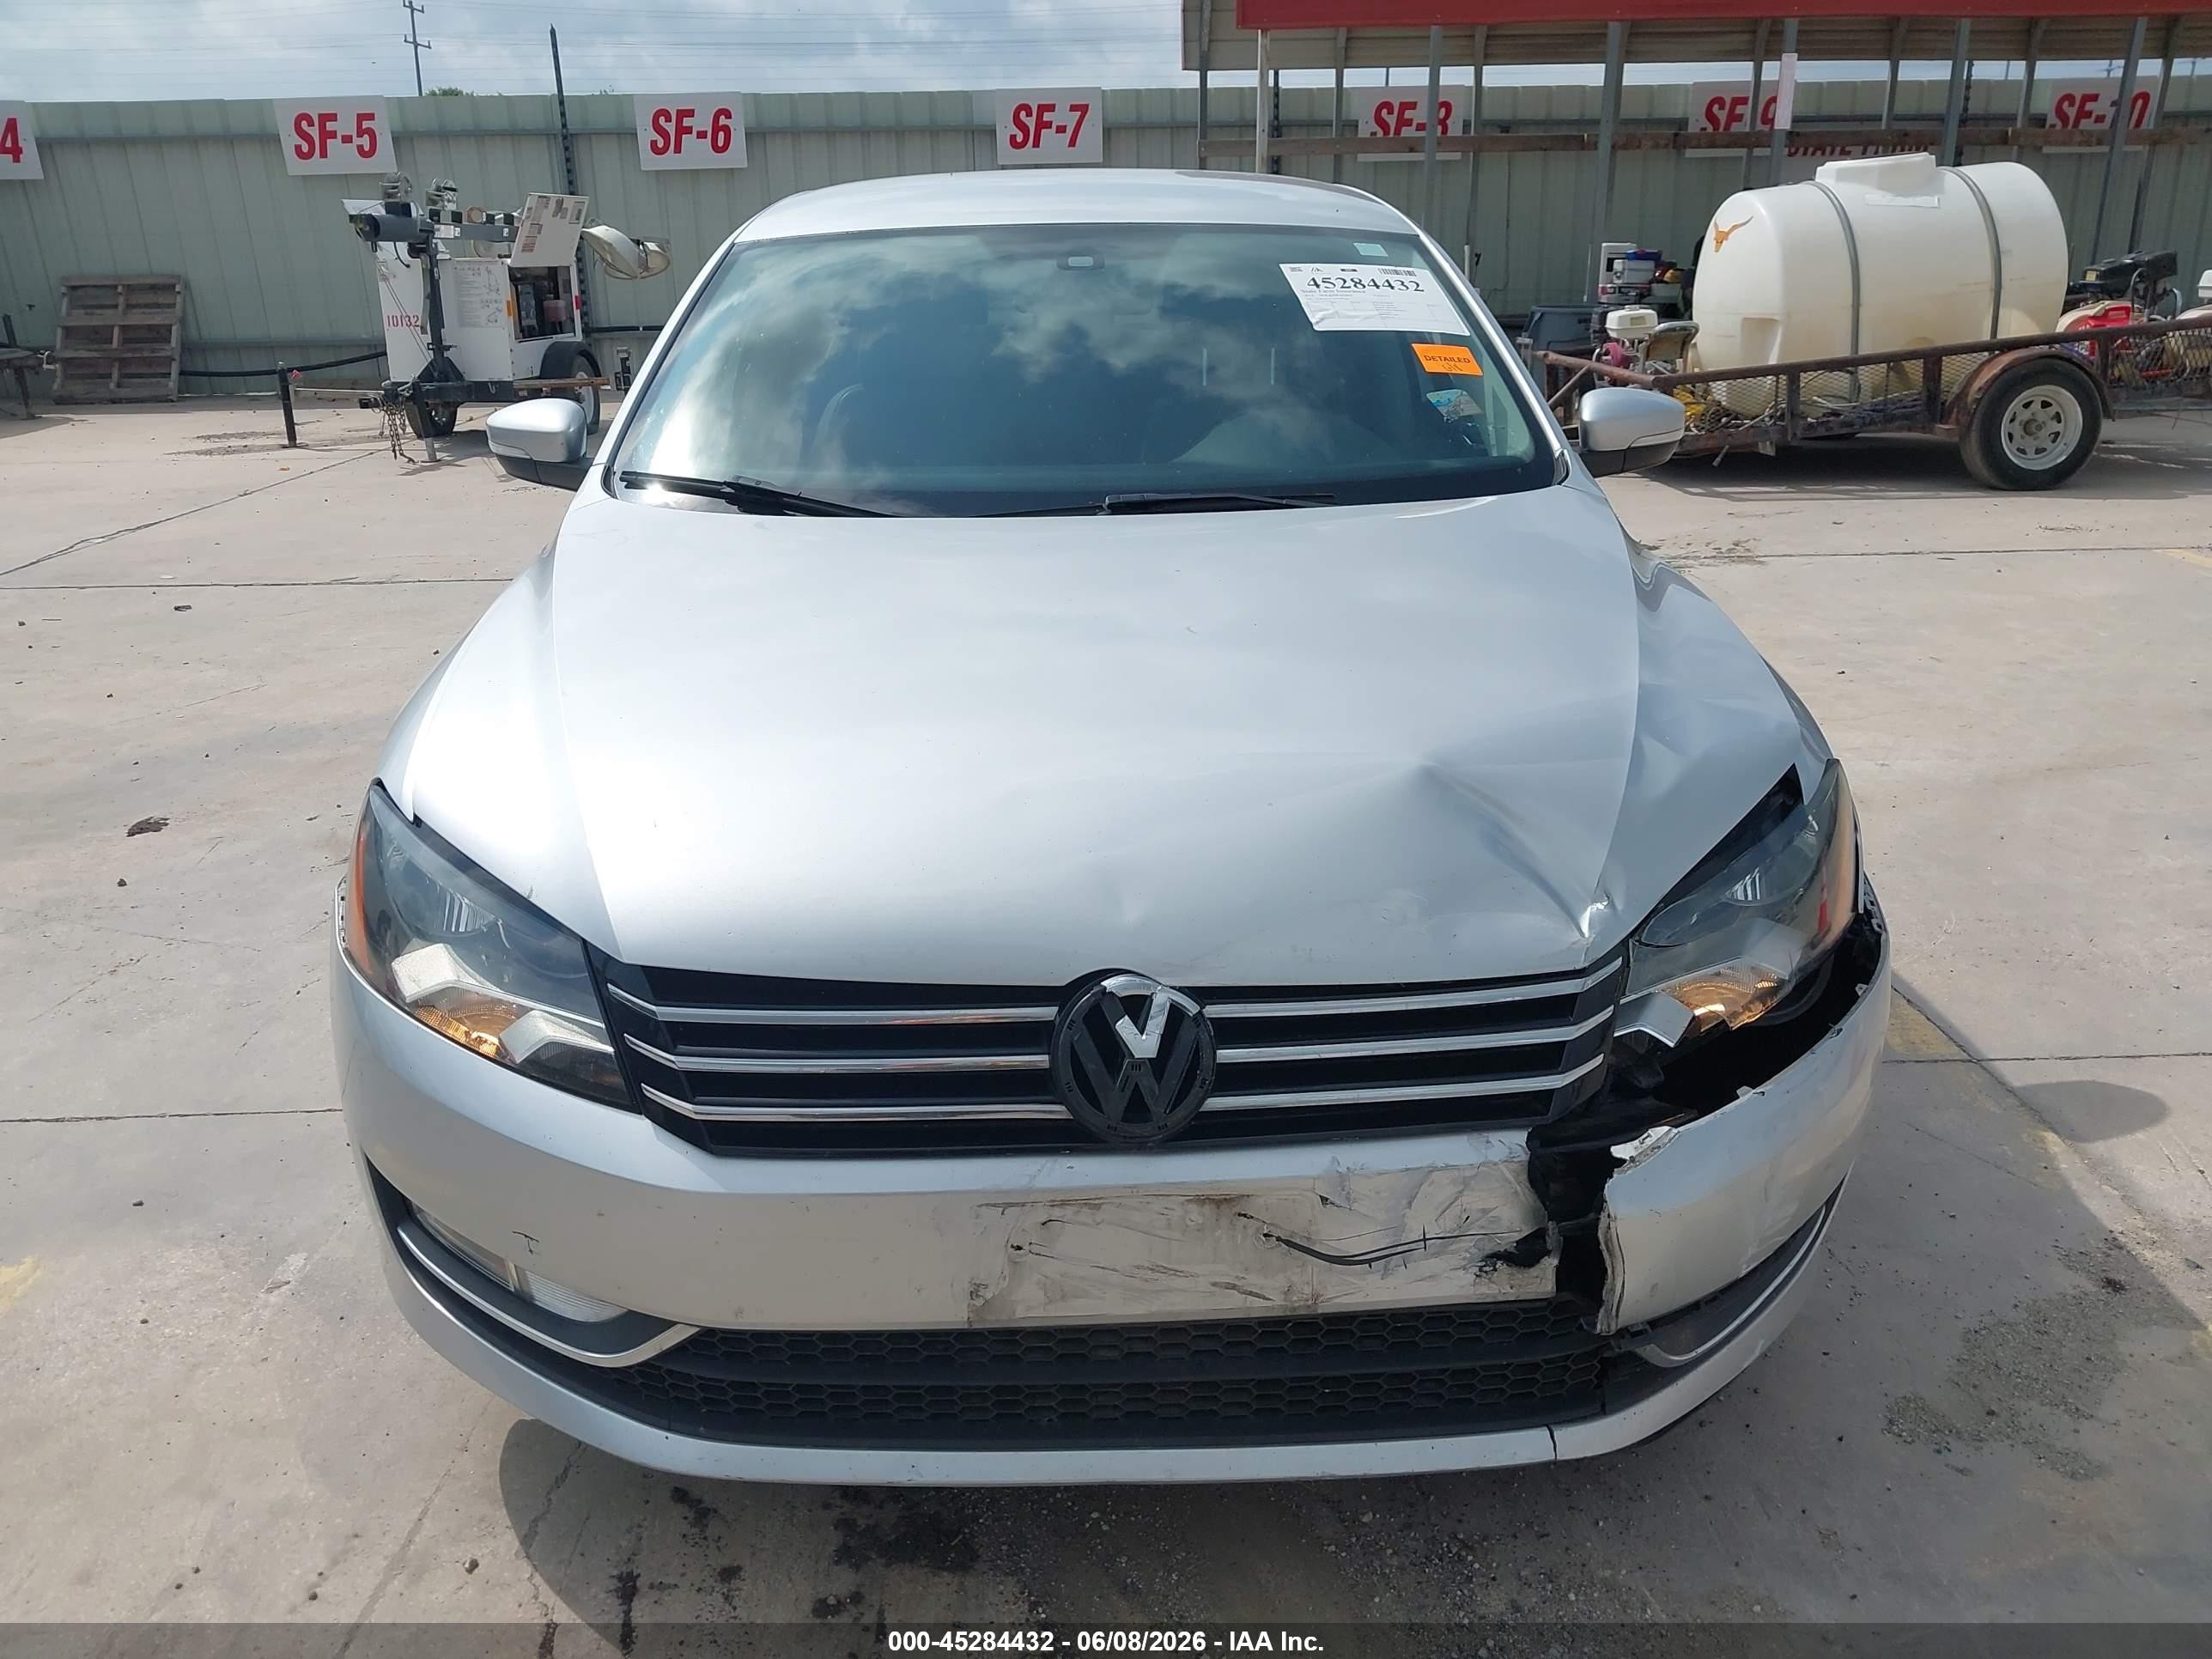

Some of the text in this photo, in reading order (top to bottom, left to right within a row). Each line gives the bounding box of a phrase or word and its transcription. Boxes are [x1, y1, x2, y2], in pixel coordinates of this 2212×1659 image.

[294, 112, 378, 160] SF-5
[649, 108, 732, 155] SF-6
[1008, 102, 1090, 149] SF-7
[1307, 276, 1425, 293] 45284432
[387, 314, 420, 328] 10132
[1423, 355, 1471, 363] DETAILED
